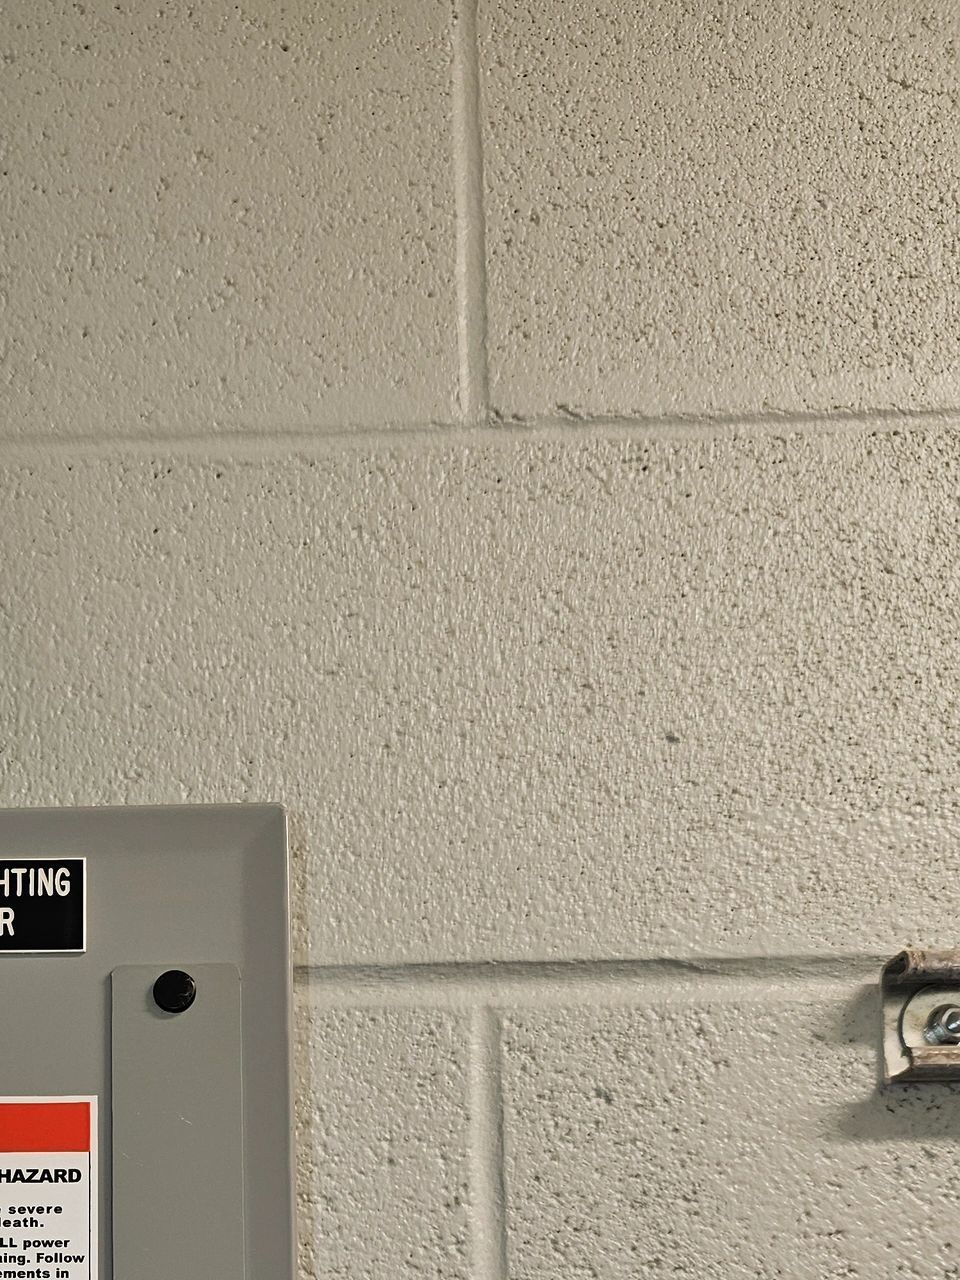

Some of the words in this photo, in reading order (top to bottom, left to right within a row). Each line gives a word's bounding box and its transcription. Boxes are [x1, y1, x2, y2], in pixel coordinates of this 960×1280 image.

[8, 1206, 63, 1214] severe
[23, 1240, 70, 1250] power
[37, 1253, 85, 1263] Follow
[56, 1268, 69, 1278] in
